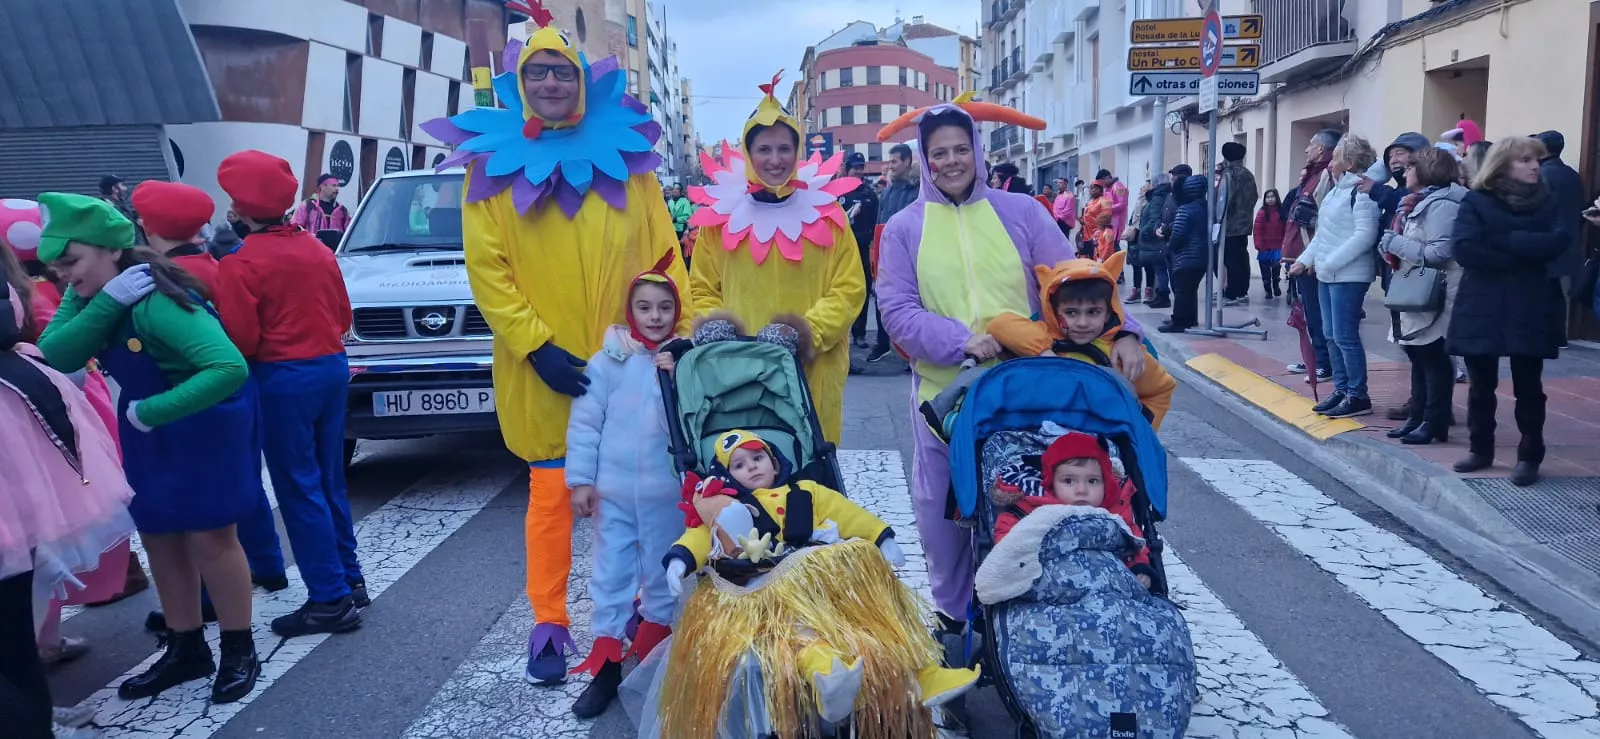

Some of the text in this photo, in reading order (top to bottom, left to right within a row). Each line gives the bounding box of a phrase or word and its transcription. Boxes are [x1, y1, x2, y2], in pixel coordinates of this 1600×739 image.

[1135, 32, 1165, 40] Posada
[1168, 31, 1178, 39] de
[1132, 58, 1148, 68] Un
[1152, 57, 1186, 67] Puto
[1156, 78, 1255, 89] otras diciones
[379, 280, 470, 288] MEDIOAMBIE
[386, 392, 490, 412] HU 8960 P
